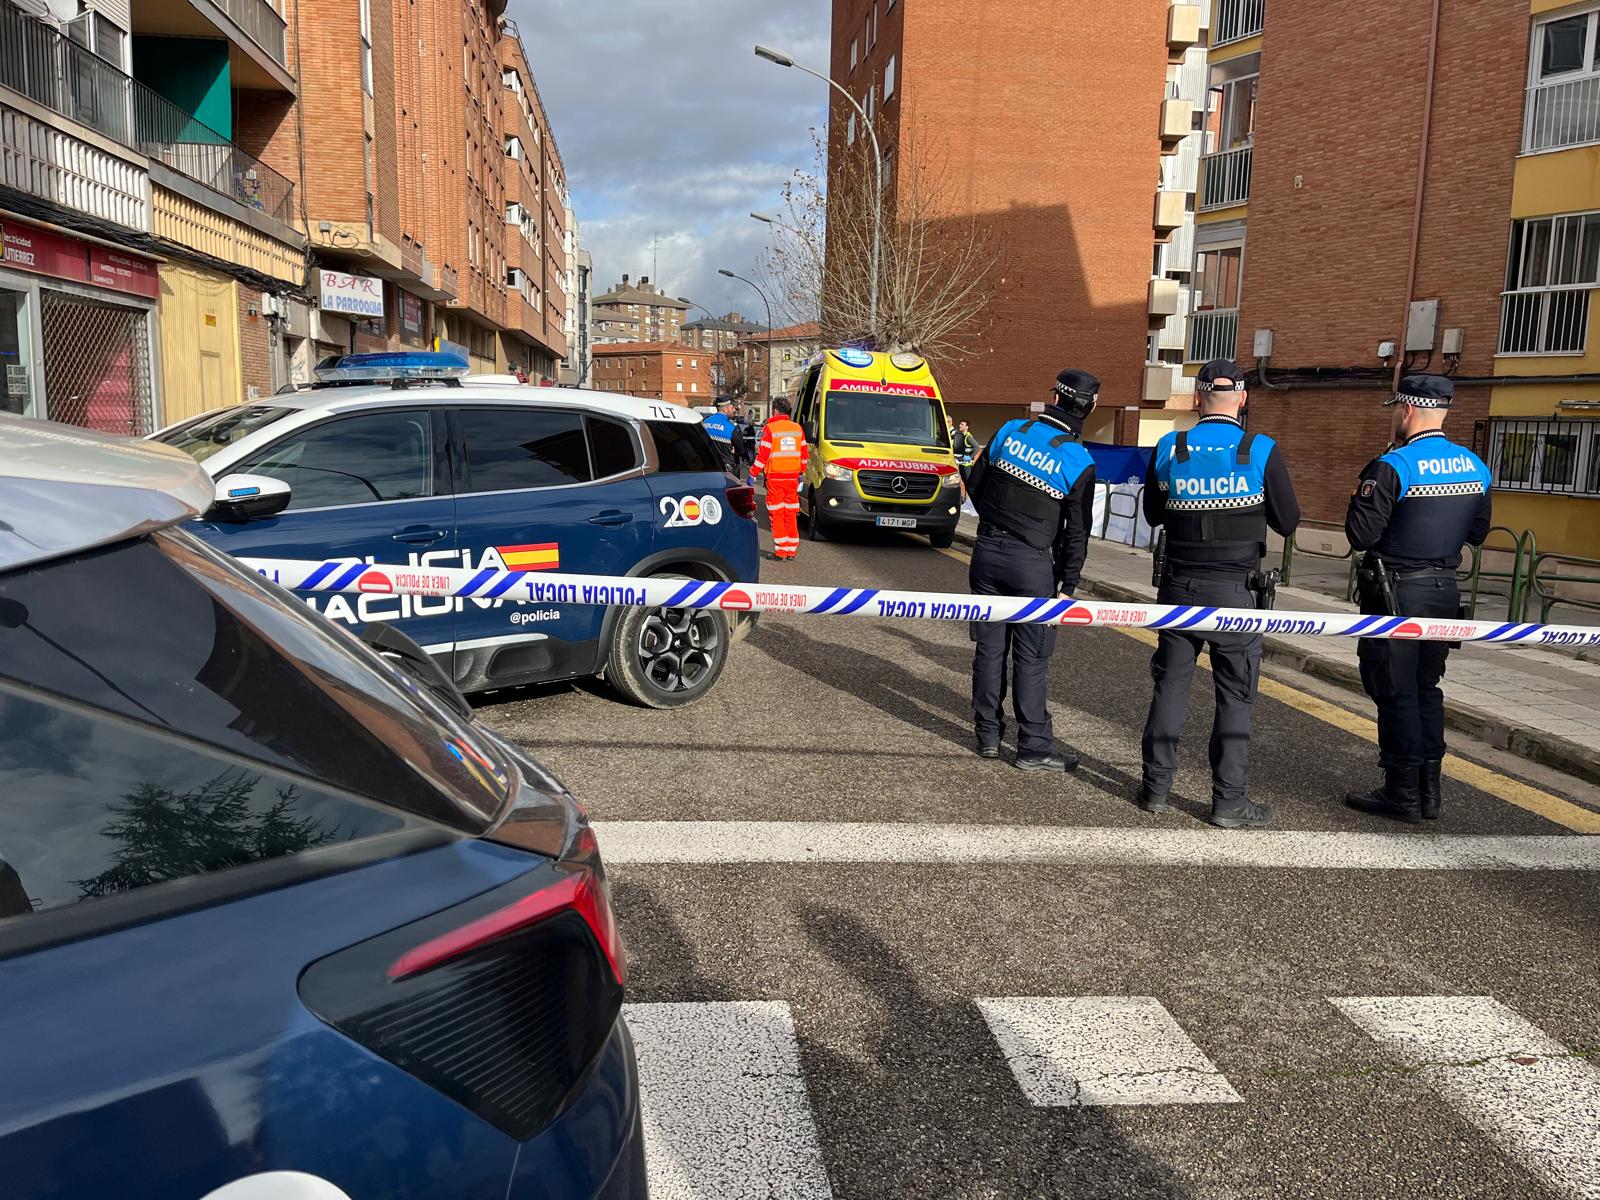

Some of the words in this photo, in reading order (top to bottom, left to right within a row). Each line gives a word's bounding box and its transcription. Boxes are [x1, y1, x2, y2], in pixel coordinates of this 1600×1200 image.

[322, 273, 380, 297] BAR
[322, 293, 333, 309] LA
[336, 295, 382, 316] PARROQUIA
[839, 384, 928, 396] AMBULANCIA
[648, 405, 676, 419] 7LT
[1417, 454, 1476, 475] POLICÍA
[1175, 471, 1250, 495] POLICÍA
[395, 573, 420, 588] POLICIA
[422, 575, 430, 588] DE
[431, 576, 450, 590] LINEA
[525, 582, 577, 603] LOCAL
[582, 585, 646, 606] POLICIA
[755, 592, 779, 605] POLICIA
[780, 593, 788, 606] DE
[790, 594, 807, 607] LINEA
[510, 609, 560, 626] @policia
[877, 600, 926, 618] LOCAL
[930, 603, 992, 621] POLICIA
[1120, 610, 1130, 622] DE
[1214, 615, 1263, 632] LOCAL
[1264, 618, 1327, 635] POLICIA
